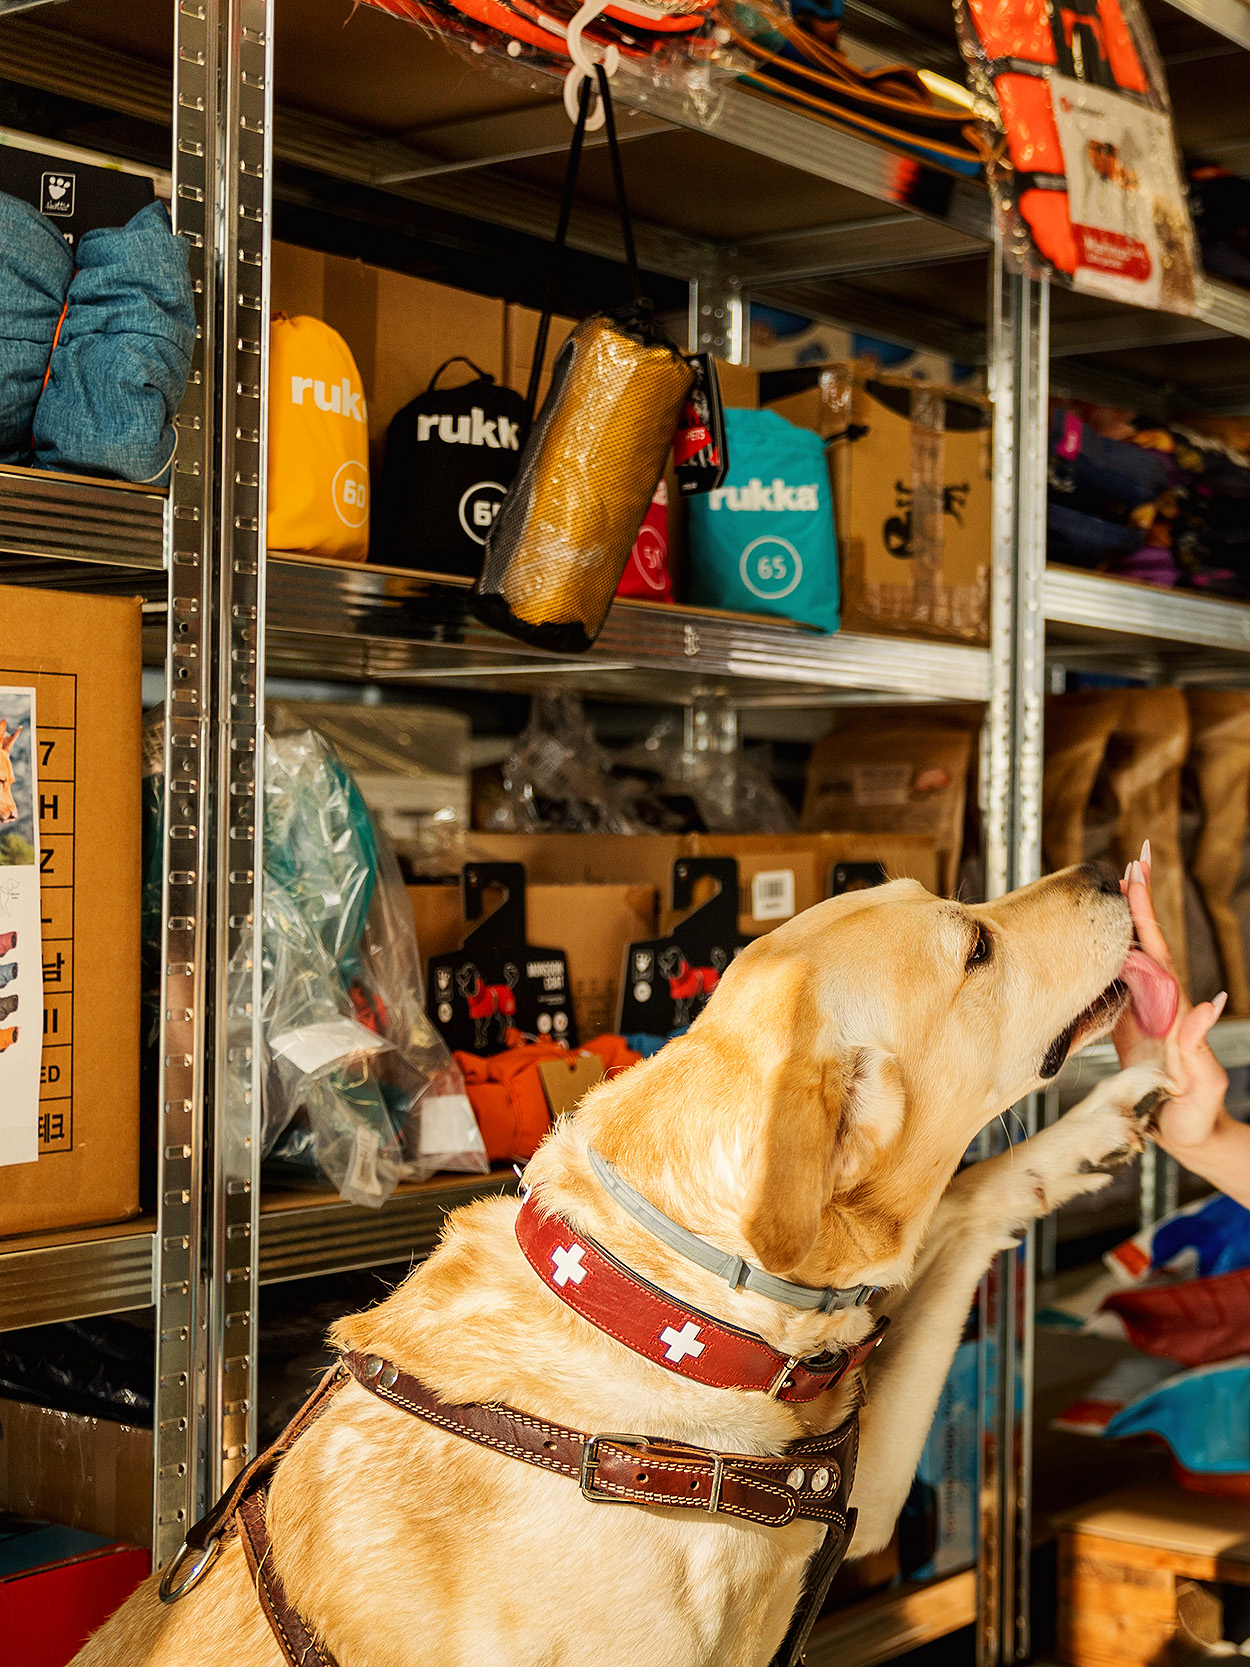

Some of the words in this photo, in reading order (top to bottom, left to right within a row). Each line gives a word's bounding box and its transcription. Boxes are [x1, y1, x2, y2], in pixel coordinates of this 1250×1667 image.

[292, 376, 367, 424] ruk
[708, 478, 819, 511] rukka
[757, 555, 786, 579] 65
[39, 741, 55, 766] 7
[40, 795, 58, 819] H
